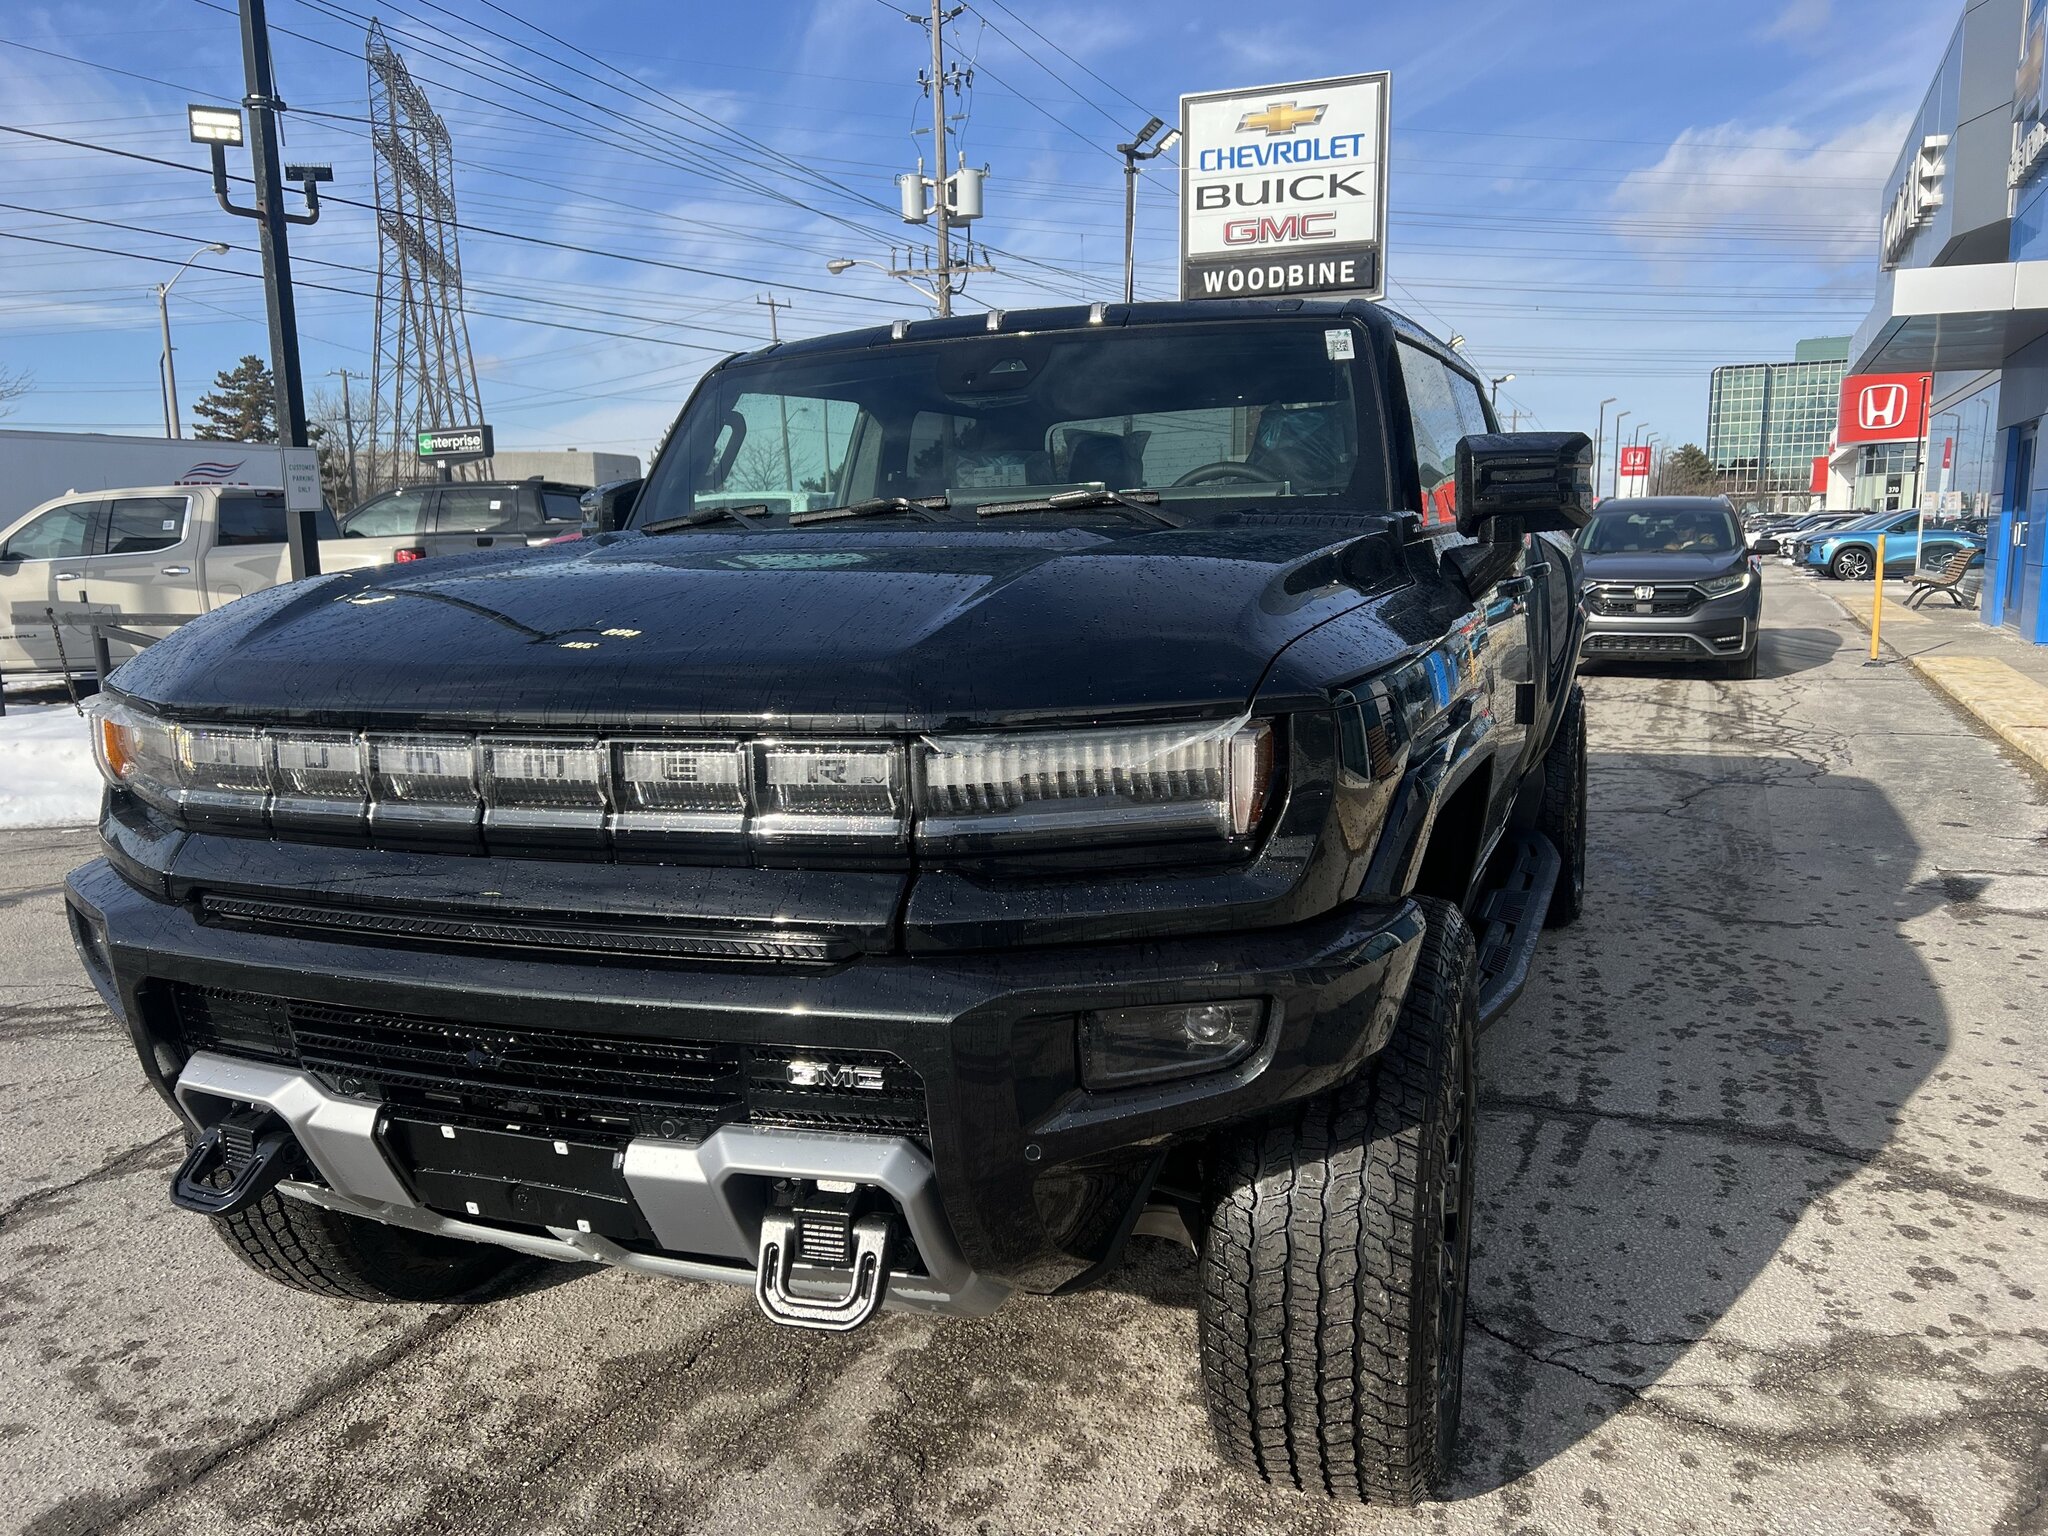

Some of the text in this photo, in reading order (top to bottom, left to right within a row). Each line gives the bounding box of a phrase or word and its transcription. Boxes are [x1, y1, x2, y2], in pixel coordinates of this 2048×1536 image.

[1200, 133, 1365, 172] CHEVROLET
[1196, 170, 1366, 211] BUICK
[1223, 210, 1337, 246] GMC
[1203, 260, 1356, 293] WOODBINE
[420, 434, 481, 450] enterprise
[786, 1061, 885, 1090] GMC
